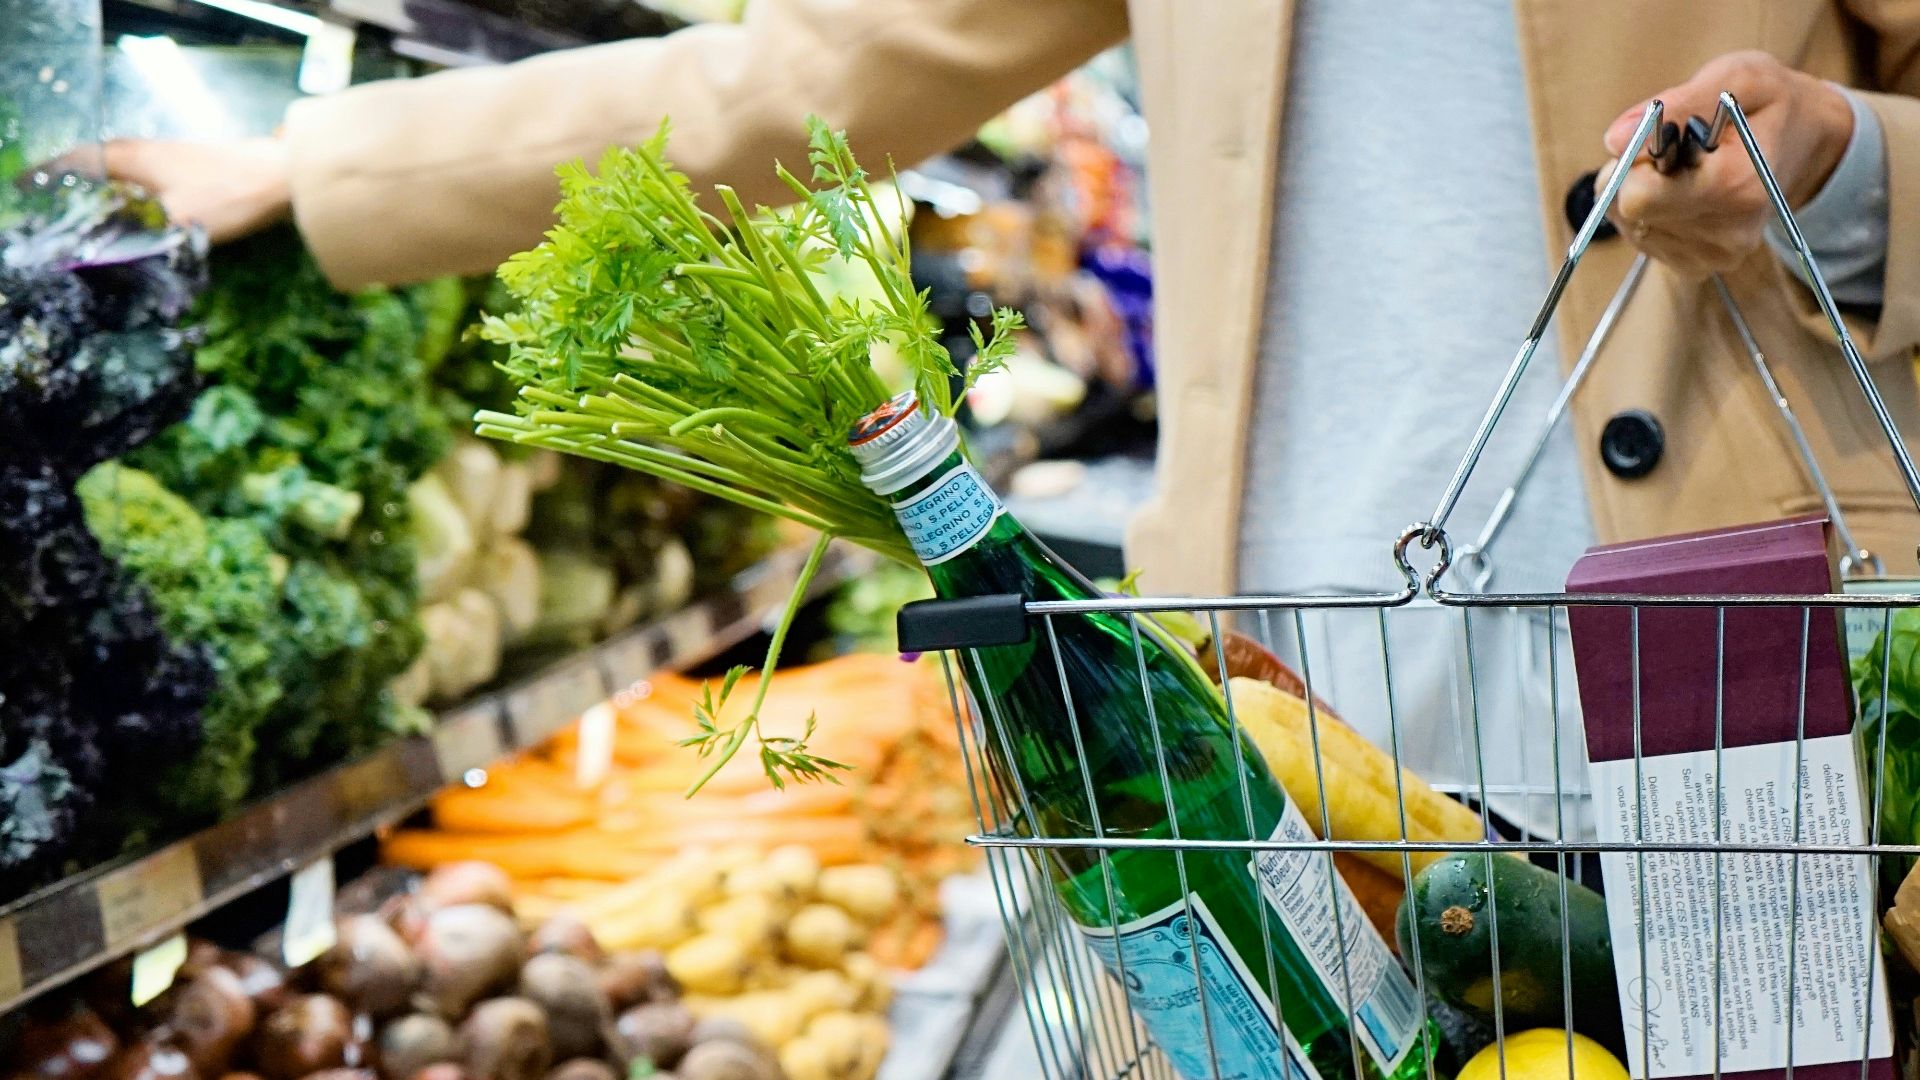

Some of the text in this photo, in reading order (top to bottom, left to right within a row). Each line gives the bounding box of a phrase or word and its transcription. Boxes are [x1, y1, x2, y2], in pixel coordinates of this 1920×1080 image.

[1682, 768, 1692, 789] Seul
[1704, 772, 1713, 784] de
[1822, 763, 1835, 805] delicious
[1834, 772, 1843, 782] At
[1617, 785, 1625, 807] vous
[1648, 776, 1661, 818] Délicieux
[1685, 792, 1692, 804] un
[1755, 788, 1764, 802] but
[1766, 780, 1777, 806] these
[1834, 785, 1847, 815] Lesley
[1620, 810, 1627, 822] ne
[1744, 788, 1756, 822] cheese
[1805, 802, 1815, 818] her
[1638, 794, 1654, 858] accompags
[1654, 820, 1661, 832] au
[1685, 805, 1699, 838] produit
[1756, 805, 1768, 830] really
[1768, 810, 1781, 841] unique
[1818, 814, 1826, 830] are
[1722, 819, 1733, 846] Stow
[1738, 823, 1748, 848] snac
[1749, 825, 1756, 834] or
[1808, 820, 1818, 844] team
[1840, 818, 1852, 848] Stow
[1761, 832, 1772, 857] she
[1821, 833, 1830, 859] mae
[1831, 832, 1842, 861] The
[1649, 861, 1658, 872] de
[1680, 852, 1694, 885] pouvait
[1692, 840, 1704, 874] aison
[1774, 845, 1787, 883] ackers
[1811, 847, 1822, 868] ink
[1625, 862, 1637, 881] plus
[1661, 872, 1669, 888] ces
[1764, 860, 1775, 885] when
[1802, 861, 1814, 894] scratch
[1814, 872, 1824, 887] the
[1824, 862, 1834, 880] with
[1671, 868, 1682, 898] POUR
[1729, 874, 1740, 902] Foods
[1756, 883, 1766, 899] We
[1827, 883, 1836, 904] care
[1835, 863, 1848, 903] fabulous
[1847, 874, 1859, 902] Foods
[1694, 782, 1703, 804] avec
[1704, 848, 1715, 876] etites
[1724, 997, 1733, 1009] de
[1695, 877, 1709, 914] fabriqué
[1766, 887, 1780, 919] topped
[1815, 889, 1826, 908] only
[1661, 891, 1677, 938] craquelins
[1675, 900, 1686, 922] CES
[1687, 888, 1700, 929] satisfaire
[1720, 894, 1733, 932] fabuleux
[1733, 904, 1744, 931] adore
[1749, 903, 1757, 923] sure
[1805, 896, 1817, 921] using
[1818, 911, 1828, 929] way
[1830, 906, 1839, 915] in
[1838, 905, 1852, 933] crisps
[1851, 905, 1859, 918] we
[1657, 924, 1666, 935] de
[1678, 925, 1689, 948] FINS
[1702, 917, 1711, 938] avec
[1750, 926, 1760, 943] you
[1761, 919, 1774, 958] addicted
[1772, 921, 1782, 940] with
[1822, 932, 1831, 941] to
[1832, 918, 1842, 942] small
[1853, 921, 1864, 941] love
[1657, 938, 1671, 976] fromage
[1670, 940, 1680, 960] sont
[1691, 932, 1704, 961] Lesley
[1705, 941, 1715, 958] des
[1735, 934, 1750, 975] fabriquer
[1754, 945, 1764, 960] will
[1773, 943, 1784, 962] your
[1812, 941, 1823, 966] finest
[1824, 944, 1834, 969] make
[1844, 936, 1854, 956] from
[1697, 964, 1706, 973] et
[1724, 934, 1740, 982] craquelins
[1757, 962, 1766, 974] be
[1767, 961, 1775, 970] to
[1664, 978, 1672, 991] ou
[1673, 963, 1687, 1014] irrésistibles
[1682, 950, 1698, 1018] CRAQUELINS
[1698, 975, 1707, 992] son
[1743, 977, 1752, 986] et
[1768, 973, 1778, 989] this
[1826, 981, 1839, 1004] great
[1732, 984, 1743, 1004] sont
[1744, 989, 1753, 1010] vous
[1769, 991, 1781, 1024] yummy
[1796, 1008, 1804, 1027] own
[1852, 999, 1864, 1032] kitchen
[1748, 1013, 1758, 1033] offrir
[1830, 1006, 1844, 1042] product
